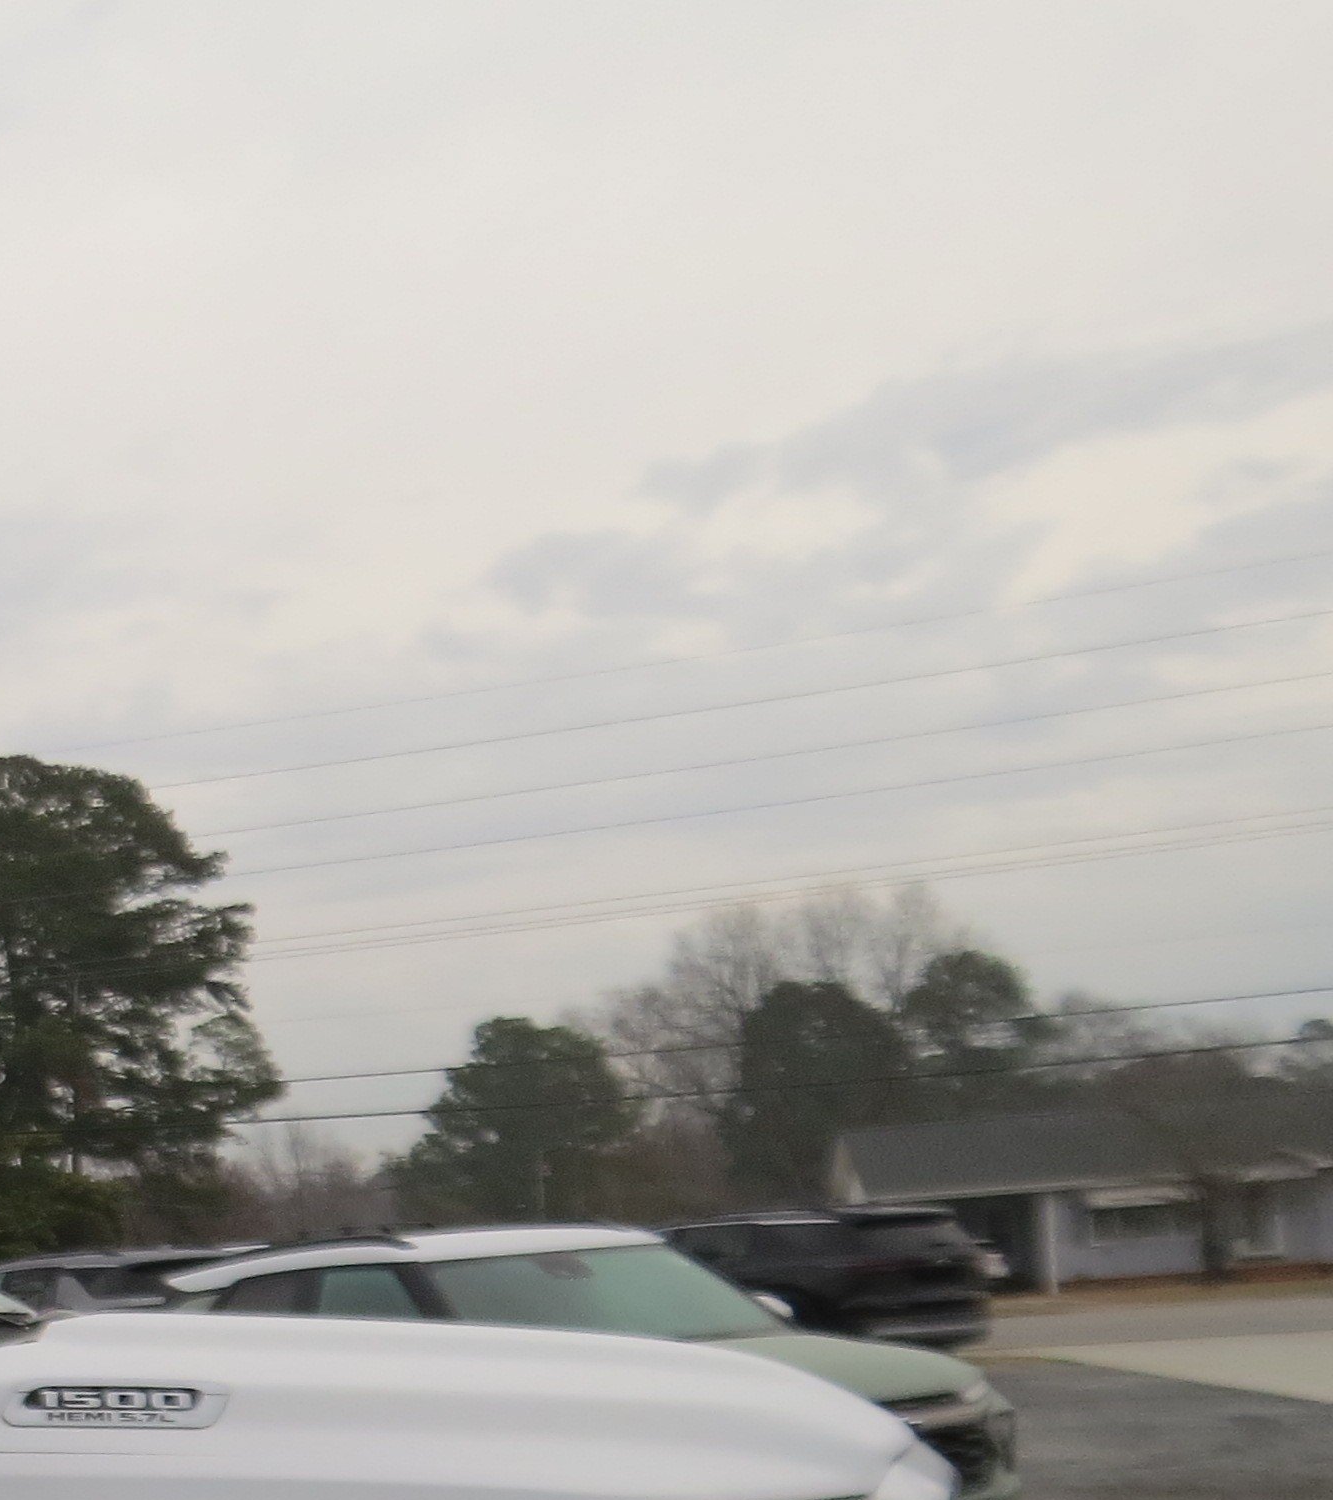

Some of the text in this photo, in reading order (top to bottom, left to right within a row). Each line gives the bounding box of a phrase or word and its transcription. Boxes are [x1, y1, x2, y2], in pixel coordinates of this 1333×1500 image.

[41, 1390, 194, 1410] 1500
[47, 1412, 176, 1423] HEMI 5.7L
